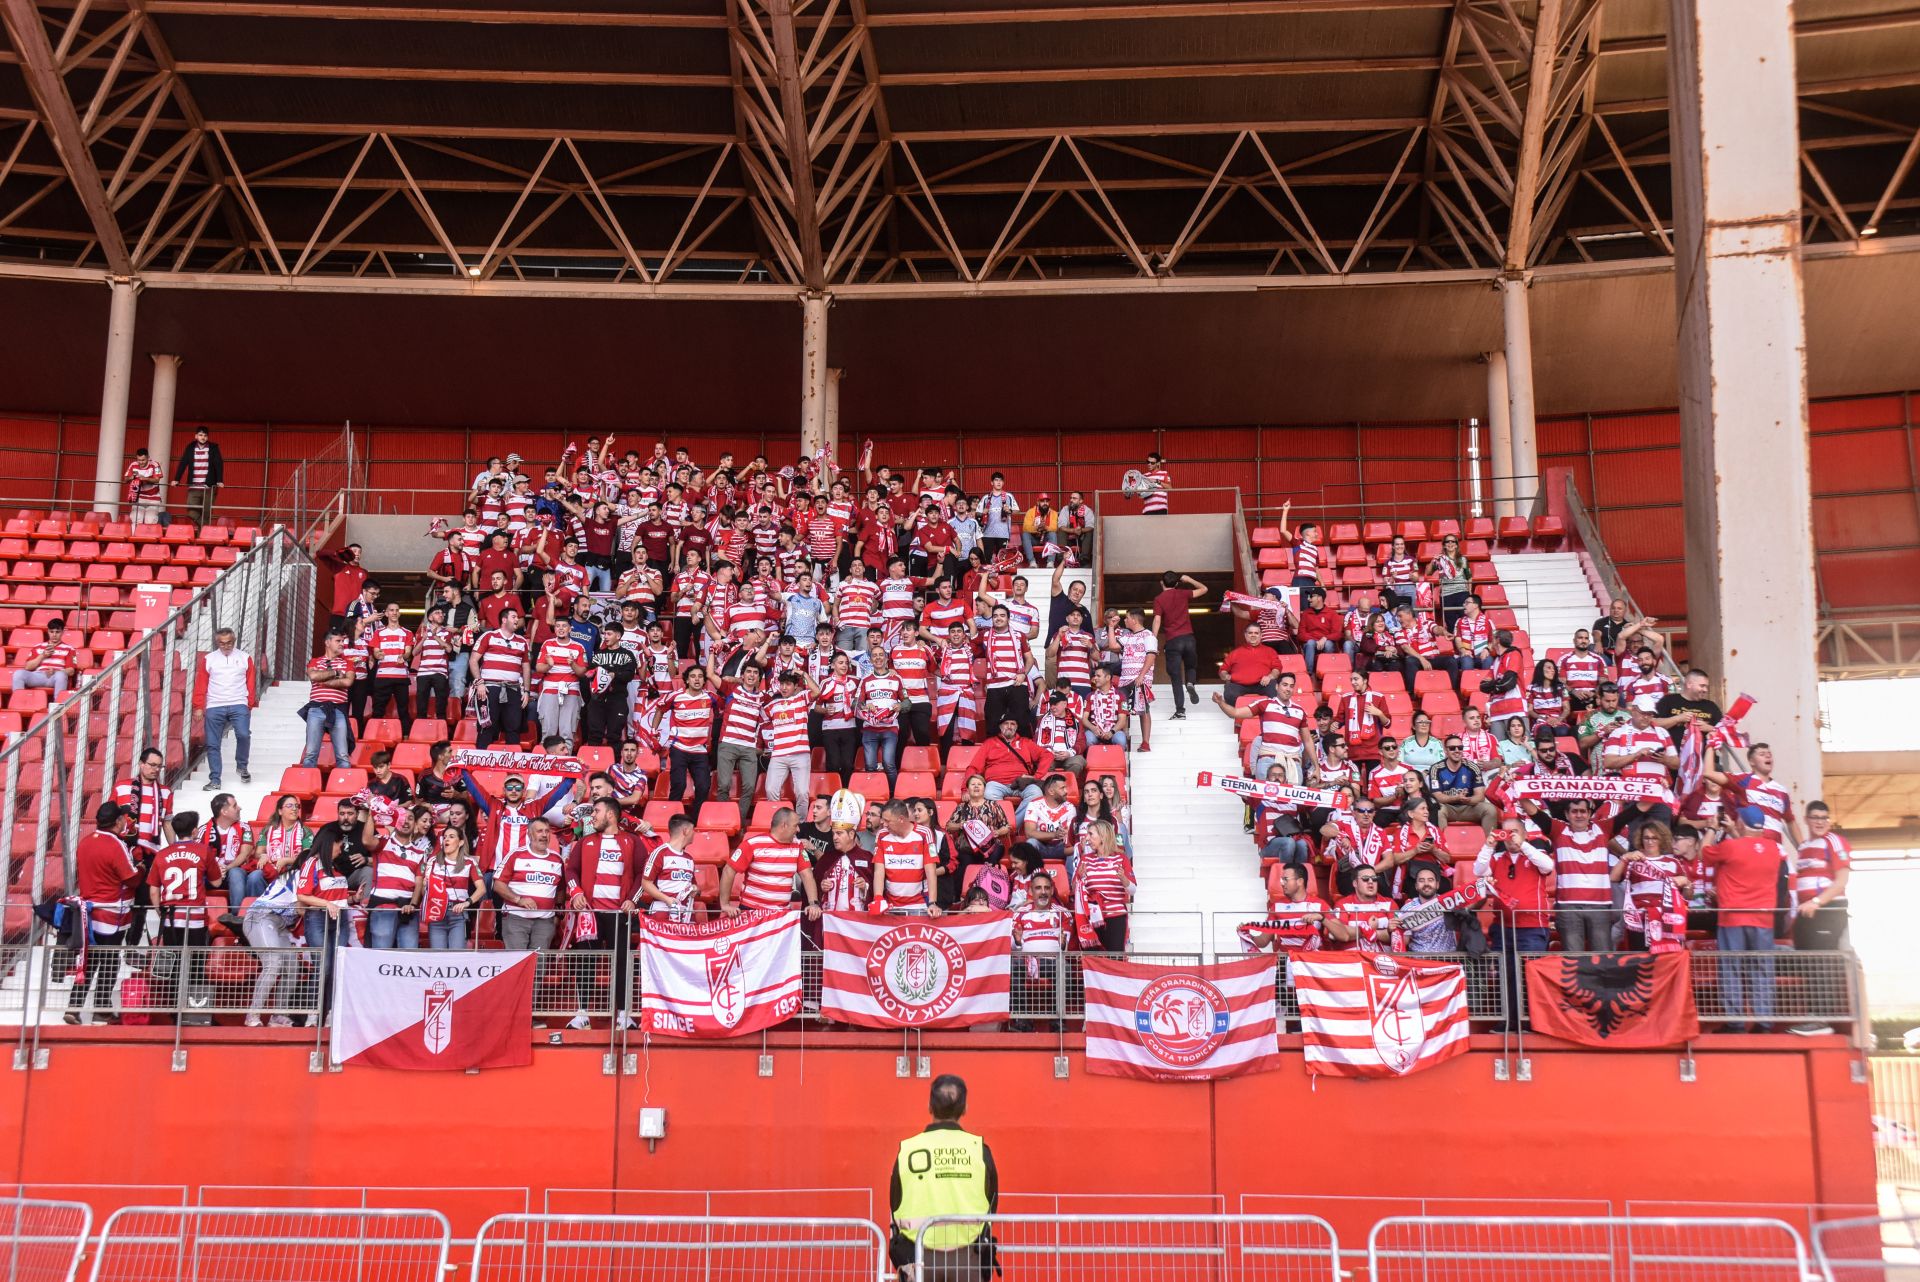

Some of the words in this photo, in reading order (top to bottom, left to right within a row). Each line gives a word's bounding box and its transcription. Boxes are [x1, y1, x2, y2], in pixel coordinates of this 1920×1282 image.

[145, 598, 157, 607] 17
[870, 691, 892, 699] wiber
[461, 750, 497, 767] Granada
[498, 752, 515, 769] Club
[517, 755, 528, 769] de
[1221, 778, 1258, 792] ETERNA
[1284, 788, 1322, 802] LUCHA
[1527, 780, 1617, 792] GRANADA
[1623, 783, 1654, 794] C.F.
[1540, 791, 1583, 799] MORIRIA
[1608, 793, 1643, 801] VERTE
[164, 866, 198, 900] 21
[526, 871, 555, 885] wiber
[699, 918, 731, 937] CLUB
[733, 913, 749, 928] DE
[869, 927, 916, 968] YOU'LL
[919, 926, 964, 970] NEVER
[378, 963, 472, 978] GRANADA
[477, 965, 502, 978] CF
[870, 975, 918, 1022] ALONE
[921, 974, 964, 1021] DRINK
[1143, 986, 1161, 1006] PEÑA
[1161, 978, 1220, 1006] GRANADINISTA
[653, 1012, 695, 1033] SINCE
[1138, 1018, 1148, 1026] 19
[1217, 1019, 1226, 1027] 31
[1148, 1039, 1175, 1061] COSTA
[1177, 1041, 1217, 1062] TROPICAL
[934, 1147, 967, 1157] grupo
[934, 1155, 971, 1166] control
